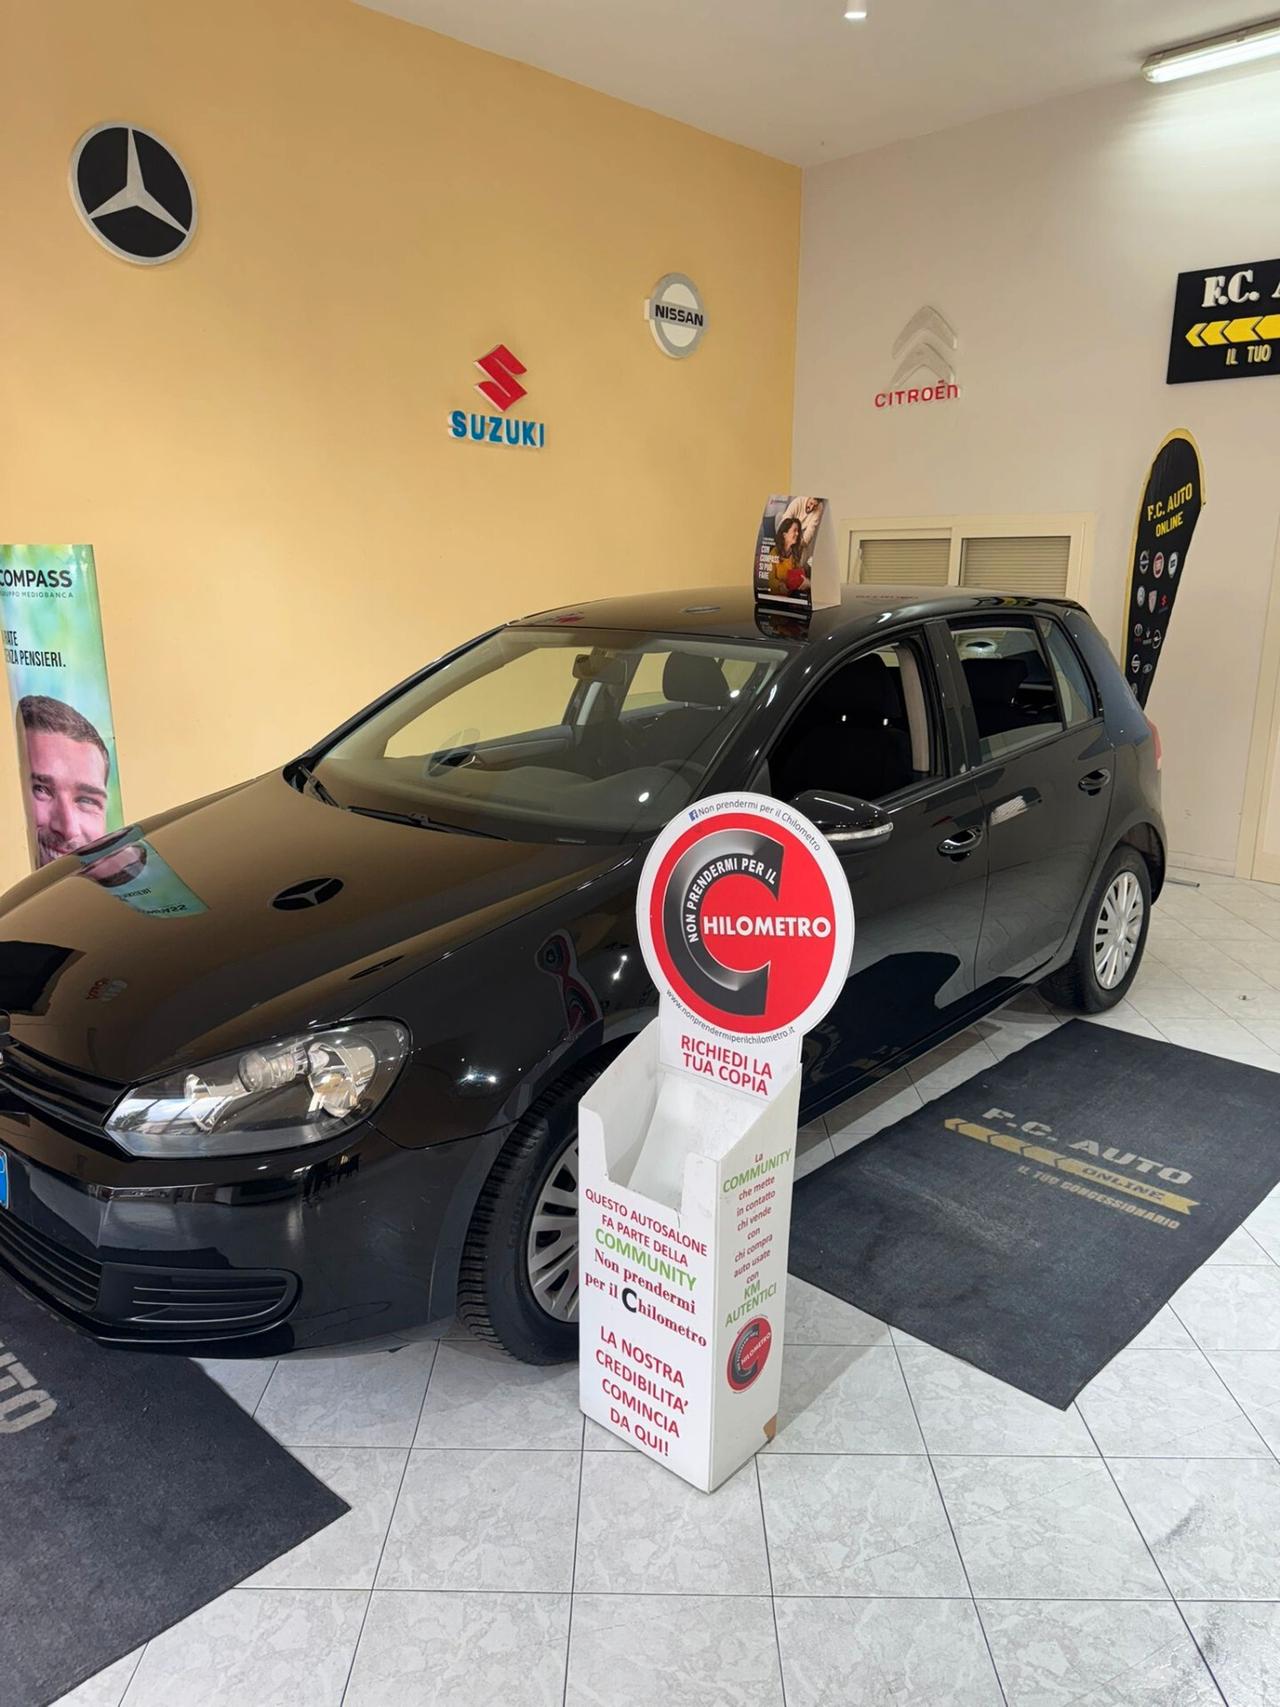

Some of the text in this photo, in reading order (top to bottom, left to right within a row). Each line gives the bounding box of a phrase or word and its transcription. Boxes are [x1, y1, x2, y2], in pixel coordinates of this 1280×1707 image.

[1201, 269, 1260, 308] F.C.
[655, 304, 703, 327] NISSAN
[1226, 344, 1272, 365] IL TUO
[451, 410, 545, 448] SUZUKI
[1147, 483, 1193, 521] F.C. AUTO
[1155, 511, 1183, 537] ONLINE
[21, 591, 74, 599] MEDIOBANCA
[19, 650, 66, 668] PENSIERI.
[698, 799, 820, 851] Non prendermi per il Chilometro
[686, 858, 777, 943] NON PRENDERMI PER IL
[666, 990, 796, 1044] www.nonprendermiperilchilometro.it
[681, 1035, 772, 1080] RICHIEDI LA
[683, 1053, 768, 1096] TUA COPIA
[755, 1152, 763, 1163] La
[982, 1107, 1193, 1185] F.C. AUTO
[723, 1150, 791, 1192] COMMUNITY
[738, 1175, 775, 1201] che mette
[1081, 1167, 1166, 1200] ONLINE
[736, 1190, 776, 1217] in contatto
[1017, 1165, 1181, 1230] IL TUO CONCESSIONARIO
[585, 1188, 707, 1256] QUESTO AUTOSALONE
[737, 1205, 772, 1232] chi vende
[747, 1227, 760, 1240] con
[595, 1228, 697, 1292] COMMUNITY
[602, 1214, 689, 1267] FA PARTE DELLA
[735, 1233, 773, 1263] chi compra
[594, 1248, 696, 1315] Non prendermi
[733, 1249, 771, 1278] auto usate
[746, 1271, 759, 1284] con
[725, 1282, 777, 1328] AUTENTICI
[744, 1280, 761, 1299] KM
[585, 1272, 707, 1348] per il Chilometro
[601, 1325, 685, 1388] LA NOSTRA
[602, 1378, 680, 1438] COMINCIA
[610, 1407, 670, 1457] DA QUI!
